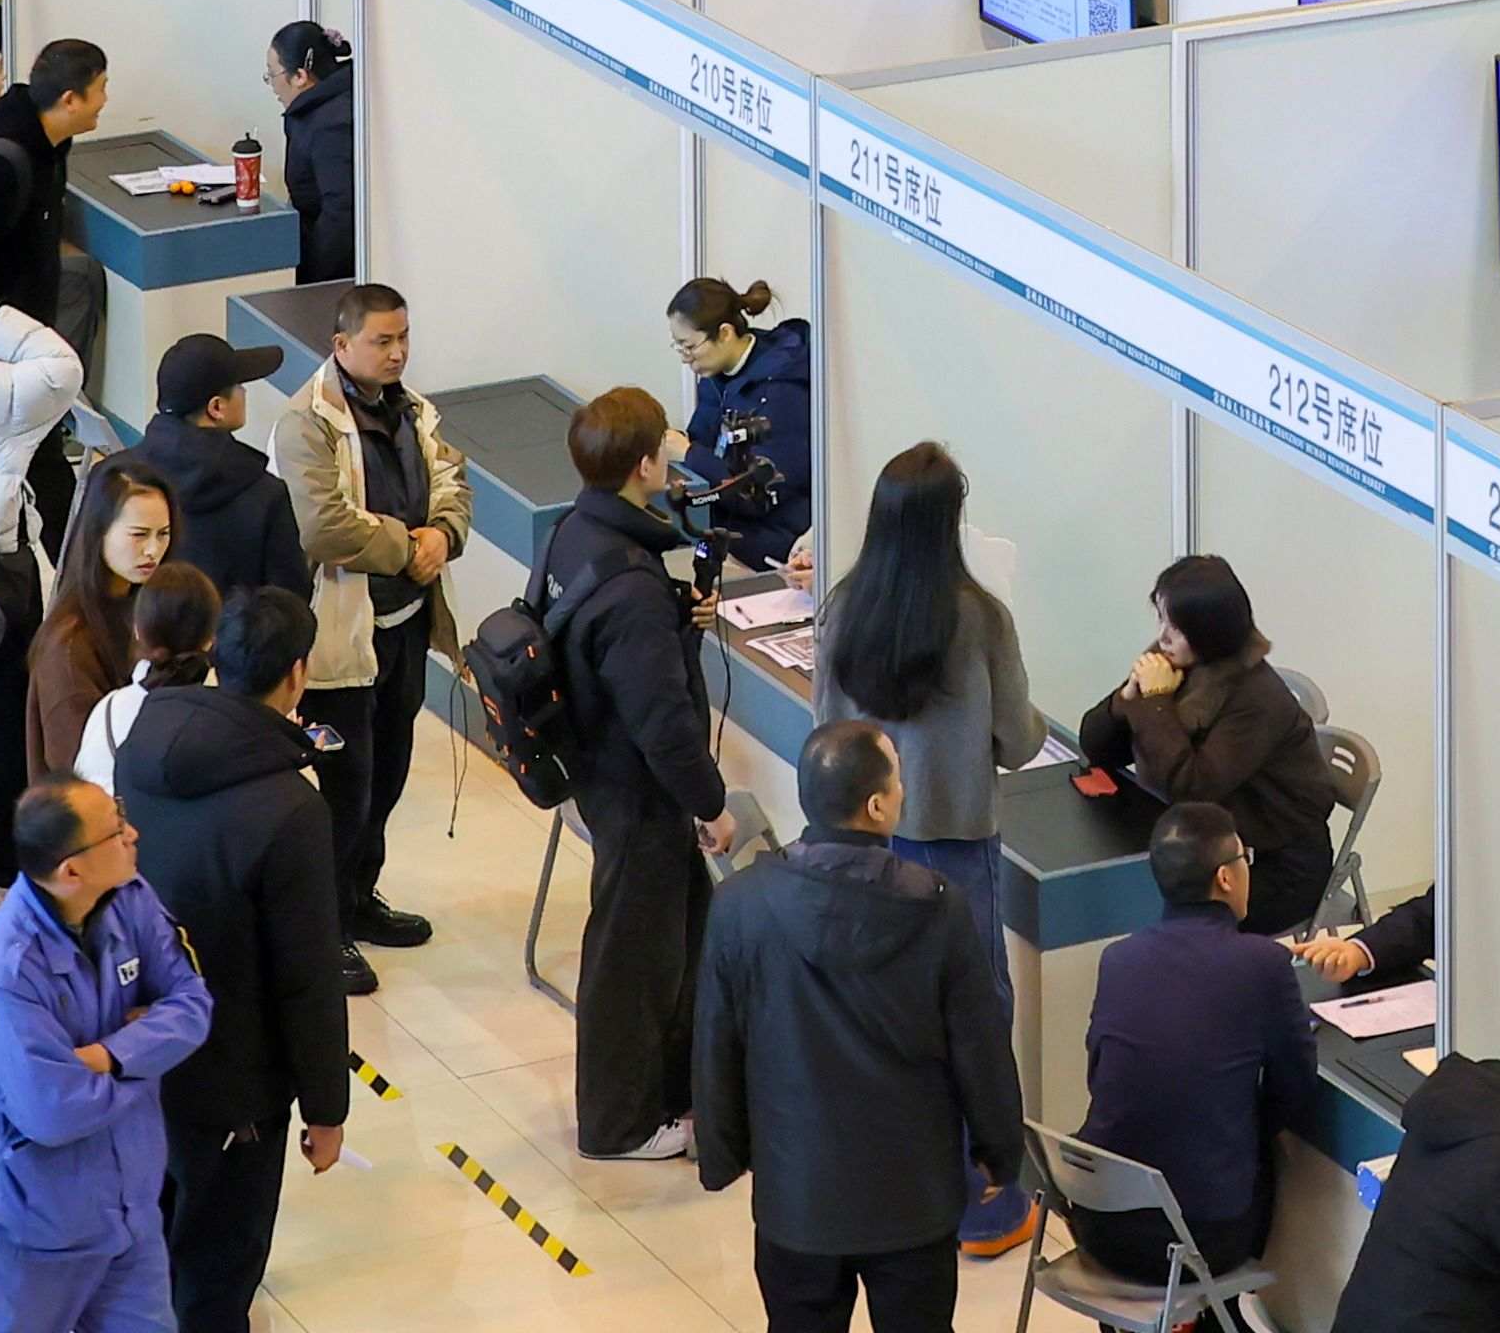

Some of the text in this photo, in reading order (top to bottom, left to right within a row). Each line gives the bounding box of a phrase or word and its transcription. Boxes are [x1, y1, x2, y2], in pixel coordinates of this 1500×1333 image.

[690, 52, 773, 136] 210号席位
[850, 137, 942, 228] 211号席位
[1269, 362, 1384, 468] 212号席位
